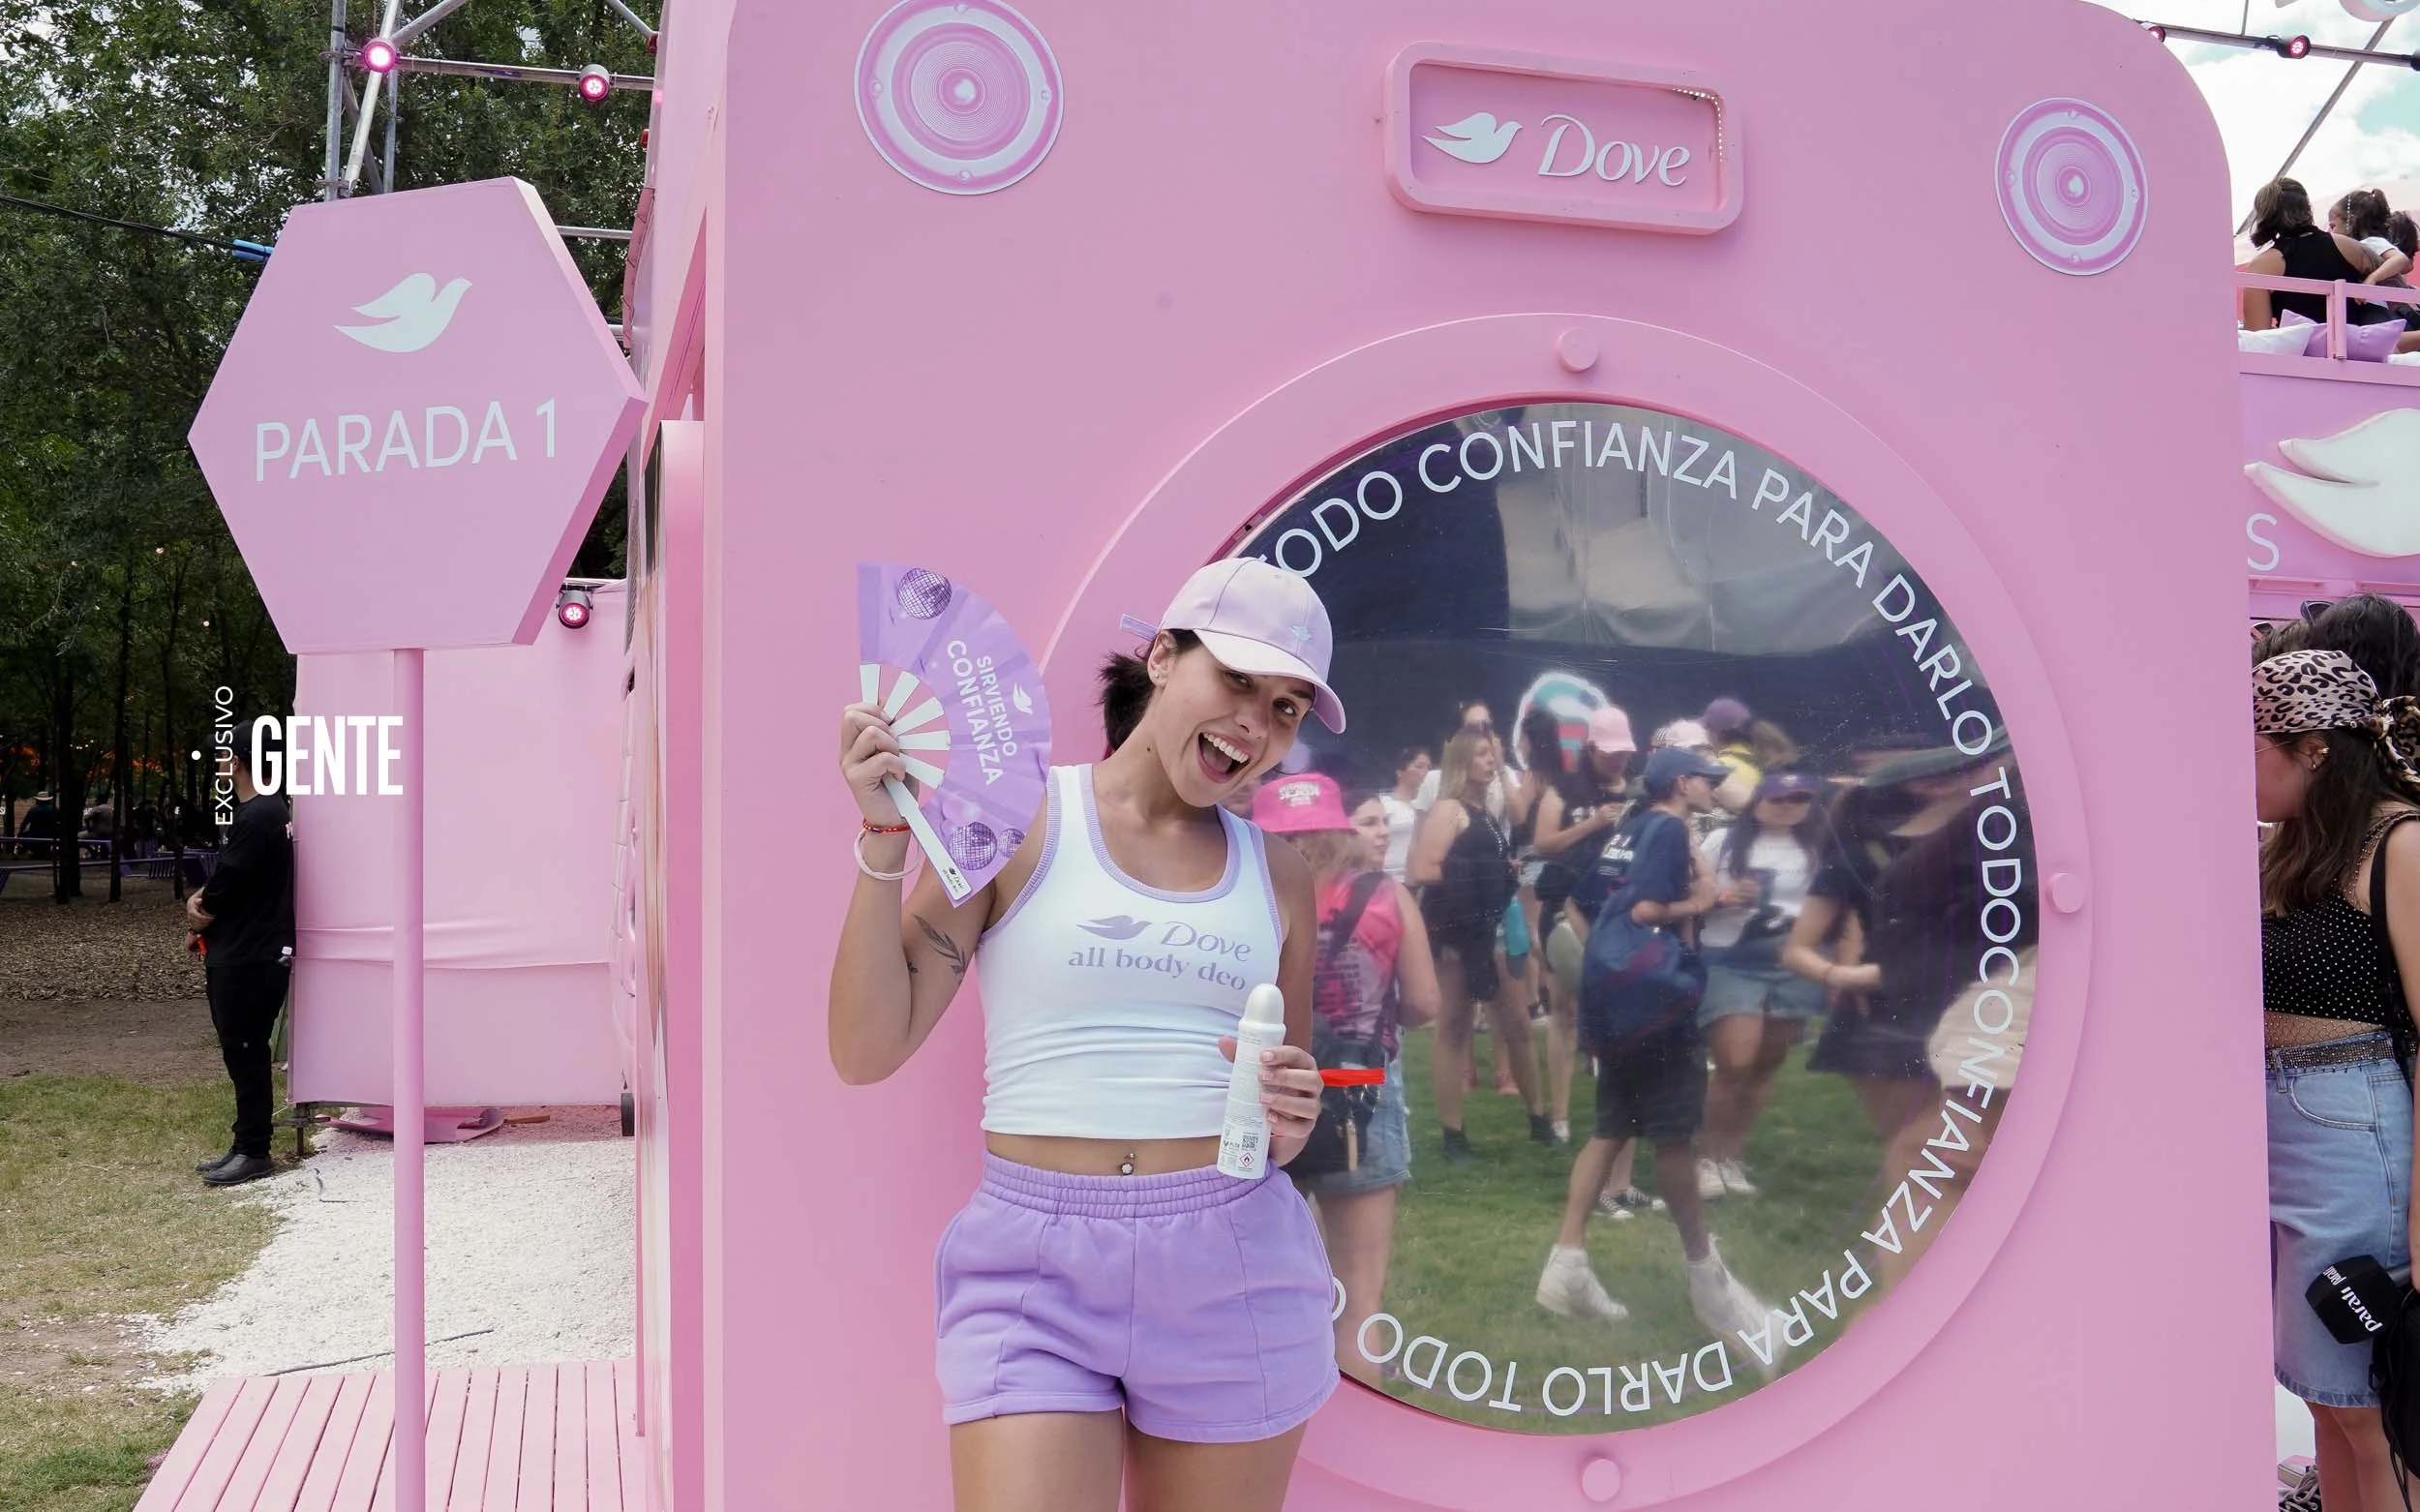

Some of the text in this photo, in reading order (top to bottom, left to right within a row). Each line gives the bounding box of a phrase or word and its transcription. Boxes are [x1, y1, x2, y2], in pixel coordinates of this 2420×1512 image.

[1537, 113, 1690, 187] Dove
[256, 398, 556, 482] PARADA 1
[1418, 420, 1738, 499] CONFIANZA
[1259, 470, 1403, 578] ODO
[1751, 468, 1874, 589] PARA
[947, 640, 1004, 786] CONFIANZA
[976, 655, 1017, 757] SIRVIENDO
[1872, 573, 1993, 756] DARLO
[1068, 947, 1247, 990] all body deo
[1160, 921, 1252, 962] Dove
[1737, 1249, 1872, 1365] PARA
[1357, 1313, 1522, 1412] TODO
[1542, 1340, 1734, 1416] DARLO
